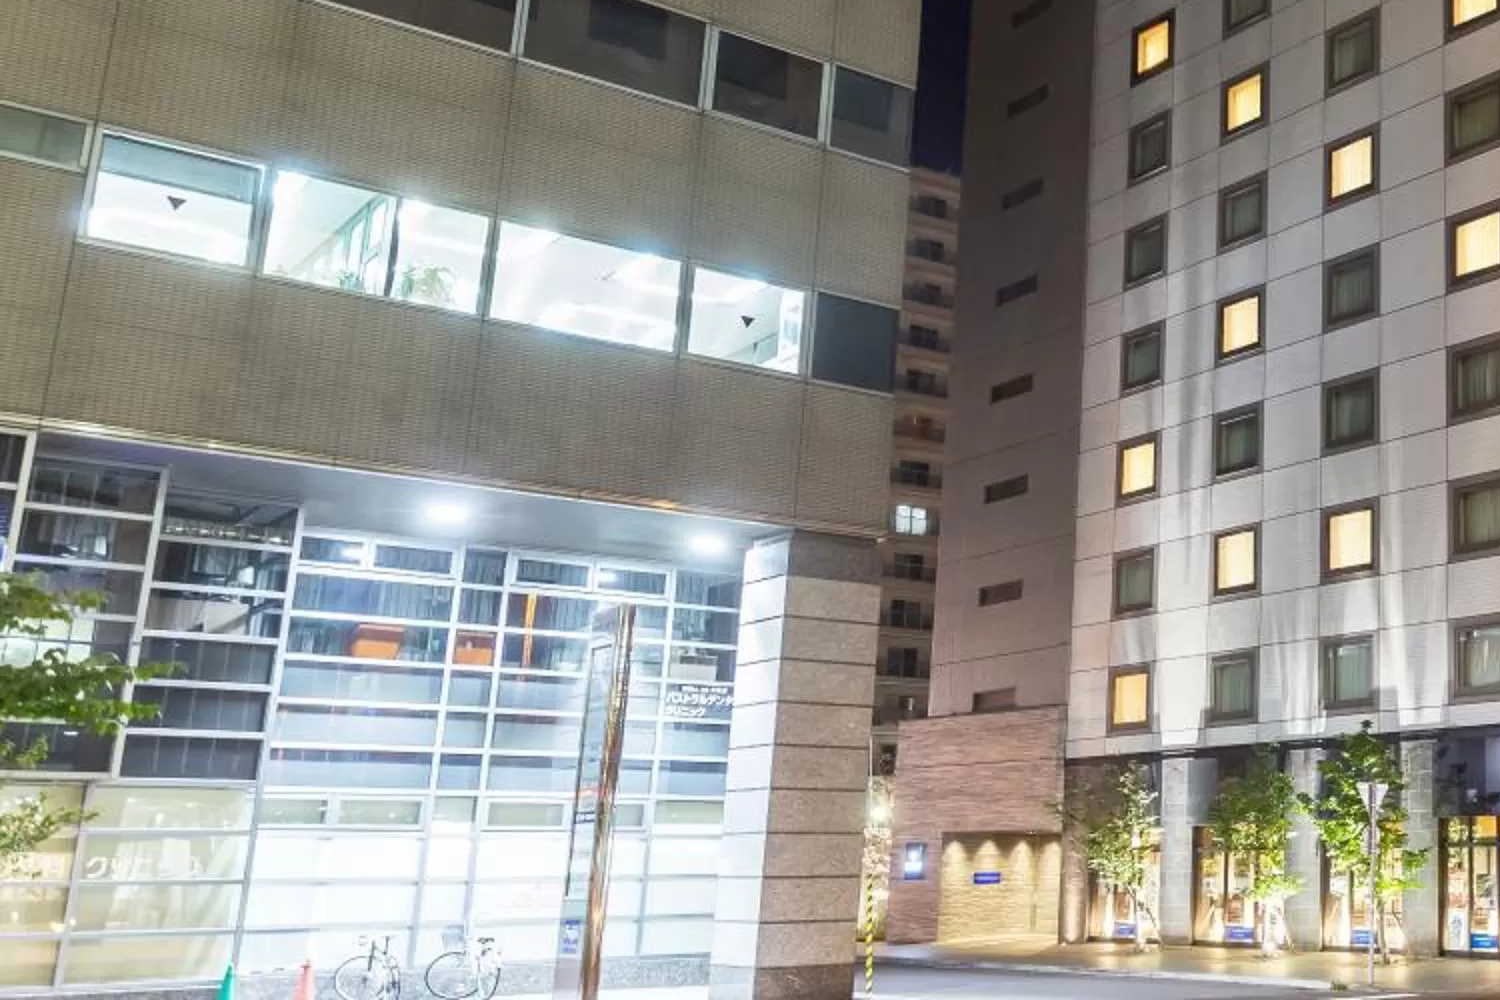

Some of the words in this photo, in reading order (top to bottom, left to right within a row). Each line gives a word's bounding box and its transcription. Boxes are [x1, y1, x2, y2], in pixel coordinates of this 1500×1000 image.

[664, 691, 734, 705] パストラルデンタ
